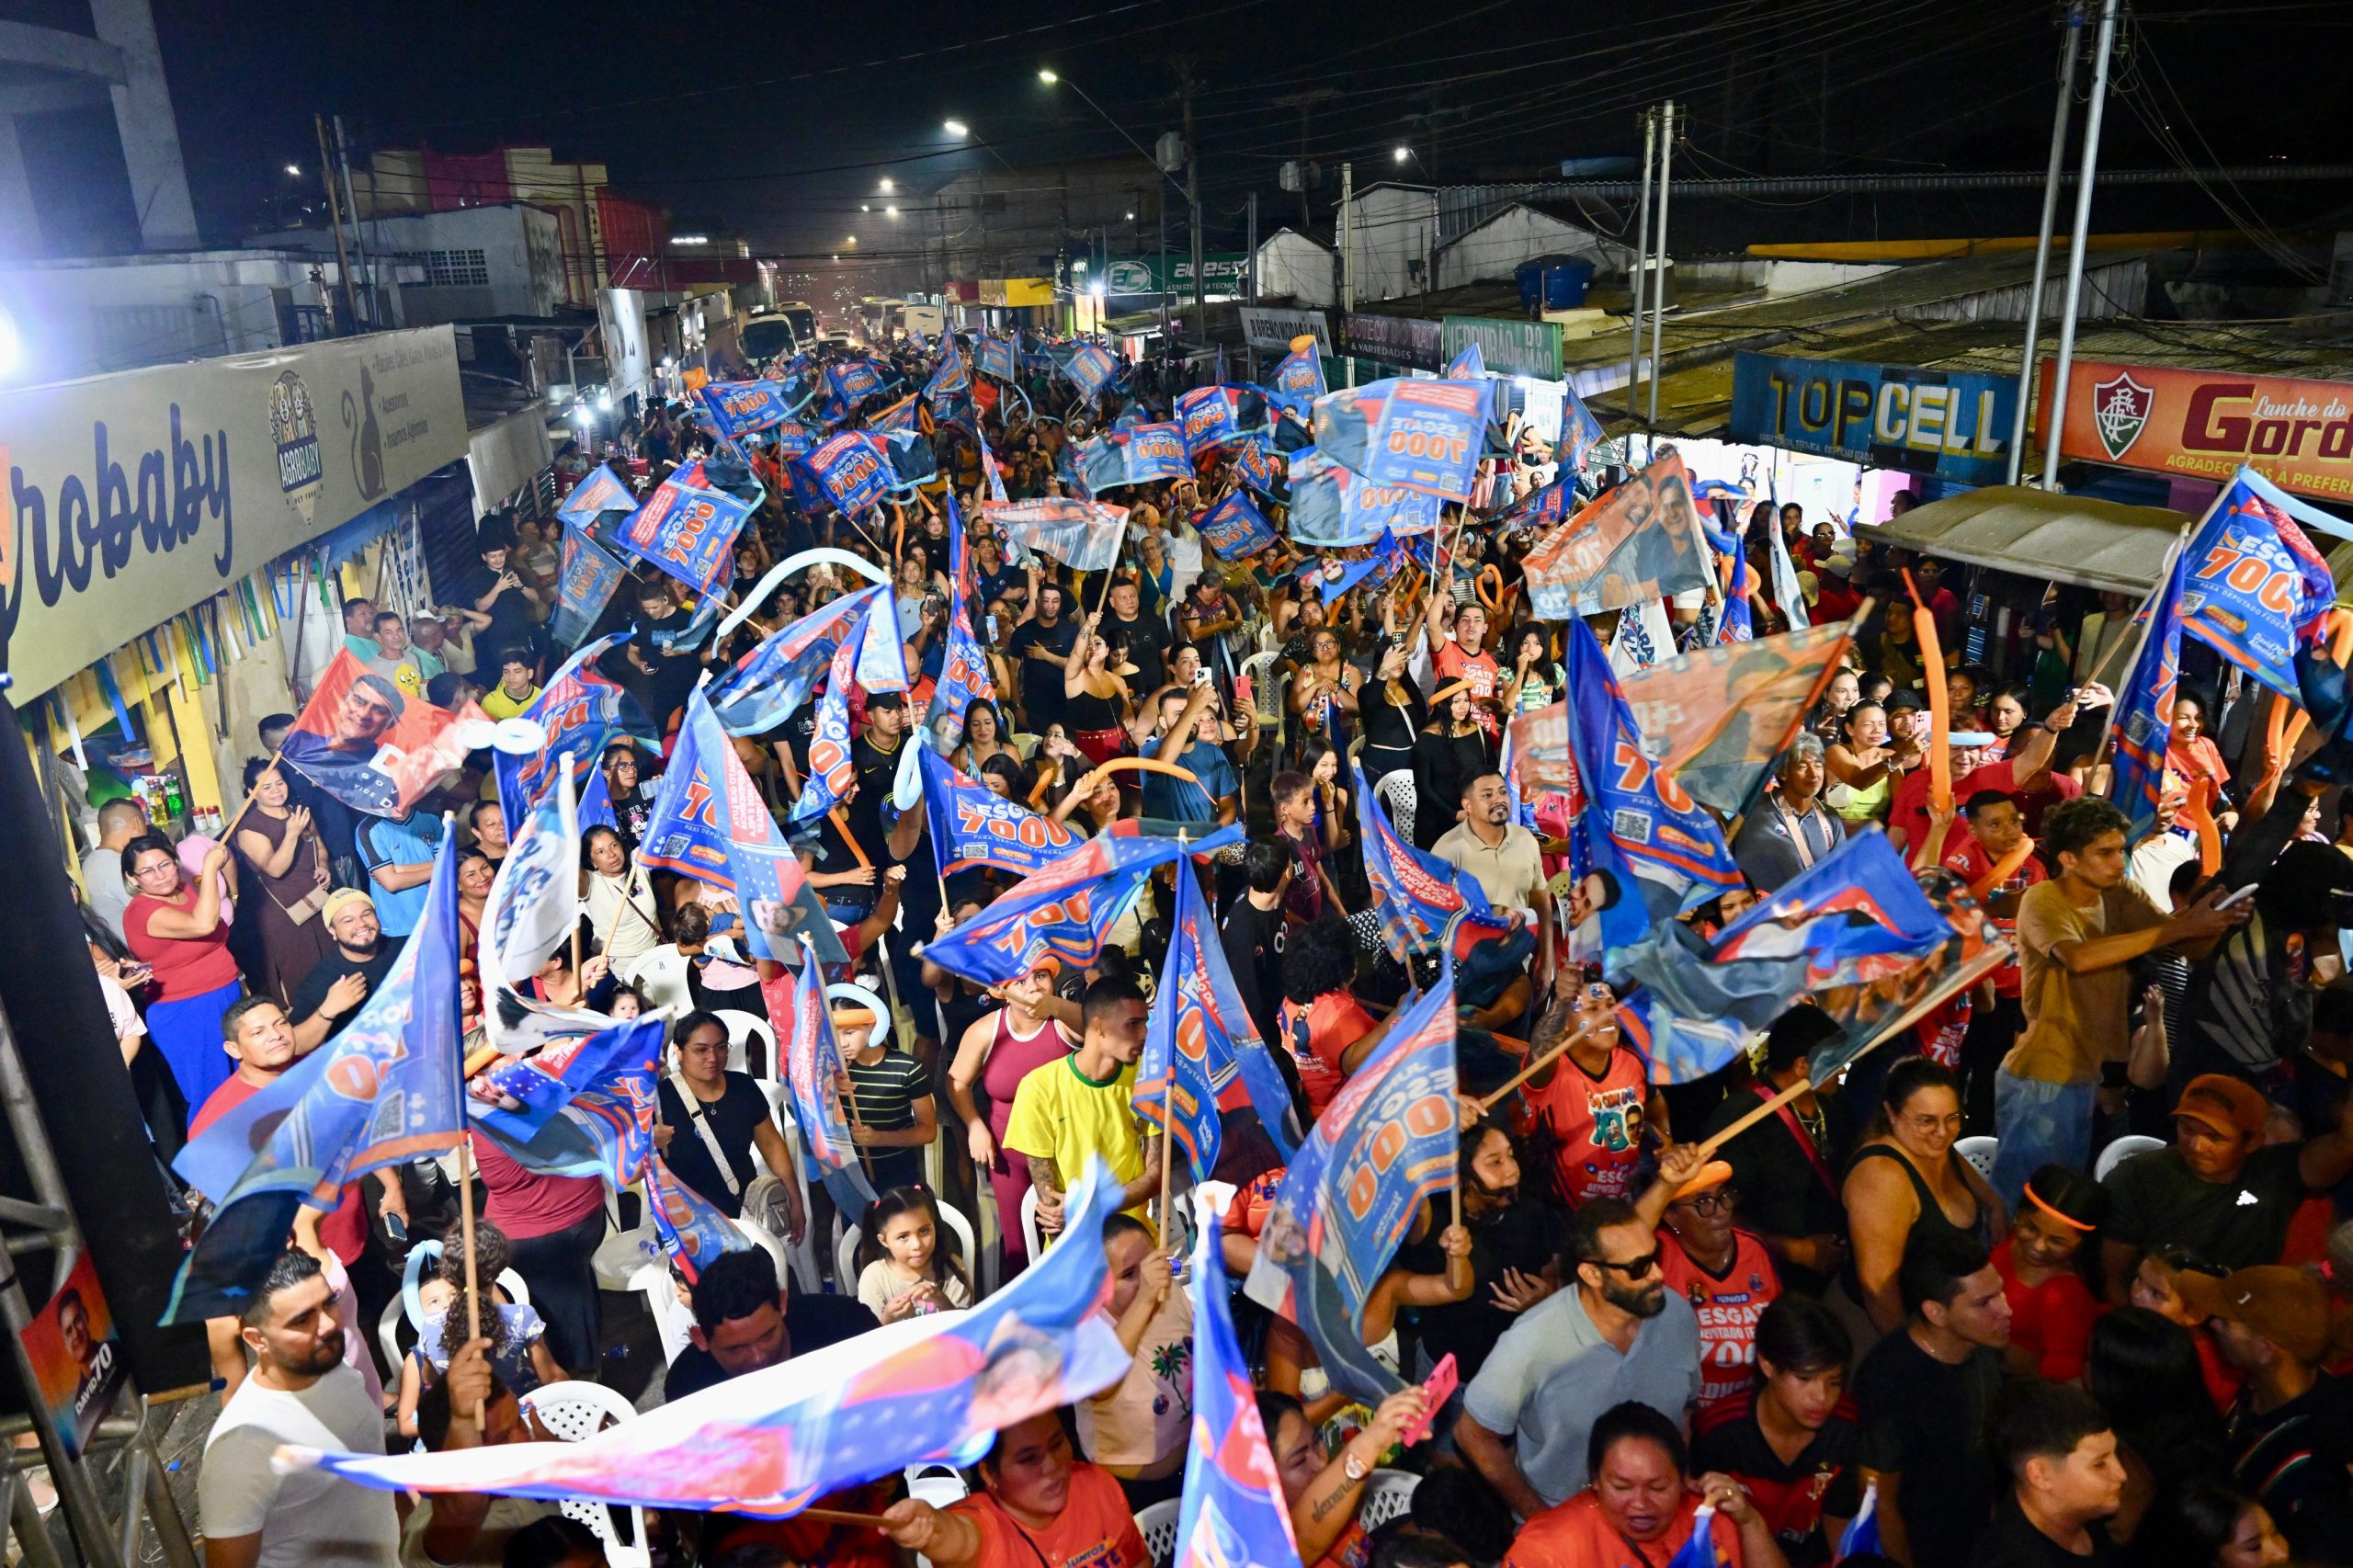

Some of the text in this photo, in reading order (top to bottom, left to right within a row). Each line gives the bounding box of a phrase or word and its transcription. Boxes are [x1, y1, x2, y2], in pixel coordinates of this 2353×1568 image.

[1525, 324, 1542, 347] DO
[1358, 342, 1412, 360] VARIEDADES
[724, 391, 769, 417] 7000
[2252, 396, 2348, 418] Lanche do
[1185, 410, 1225, 439] 7000
[279, 441, 321, 488] AGROBABY
[830, 457, 879, 499] 7000
[666, 502, 716, 567] 7000
[2199, 582, 2219, 596] PARA
[957, 810, 1072, 848] 7000
[1293, 860, 1305, 876] 10
[75, 1343, 112, 1416] DAVID 70
